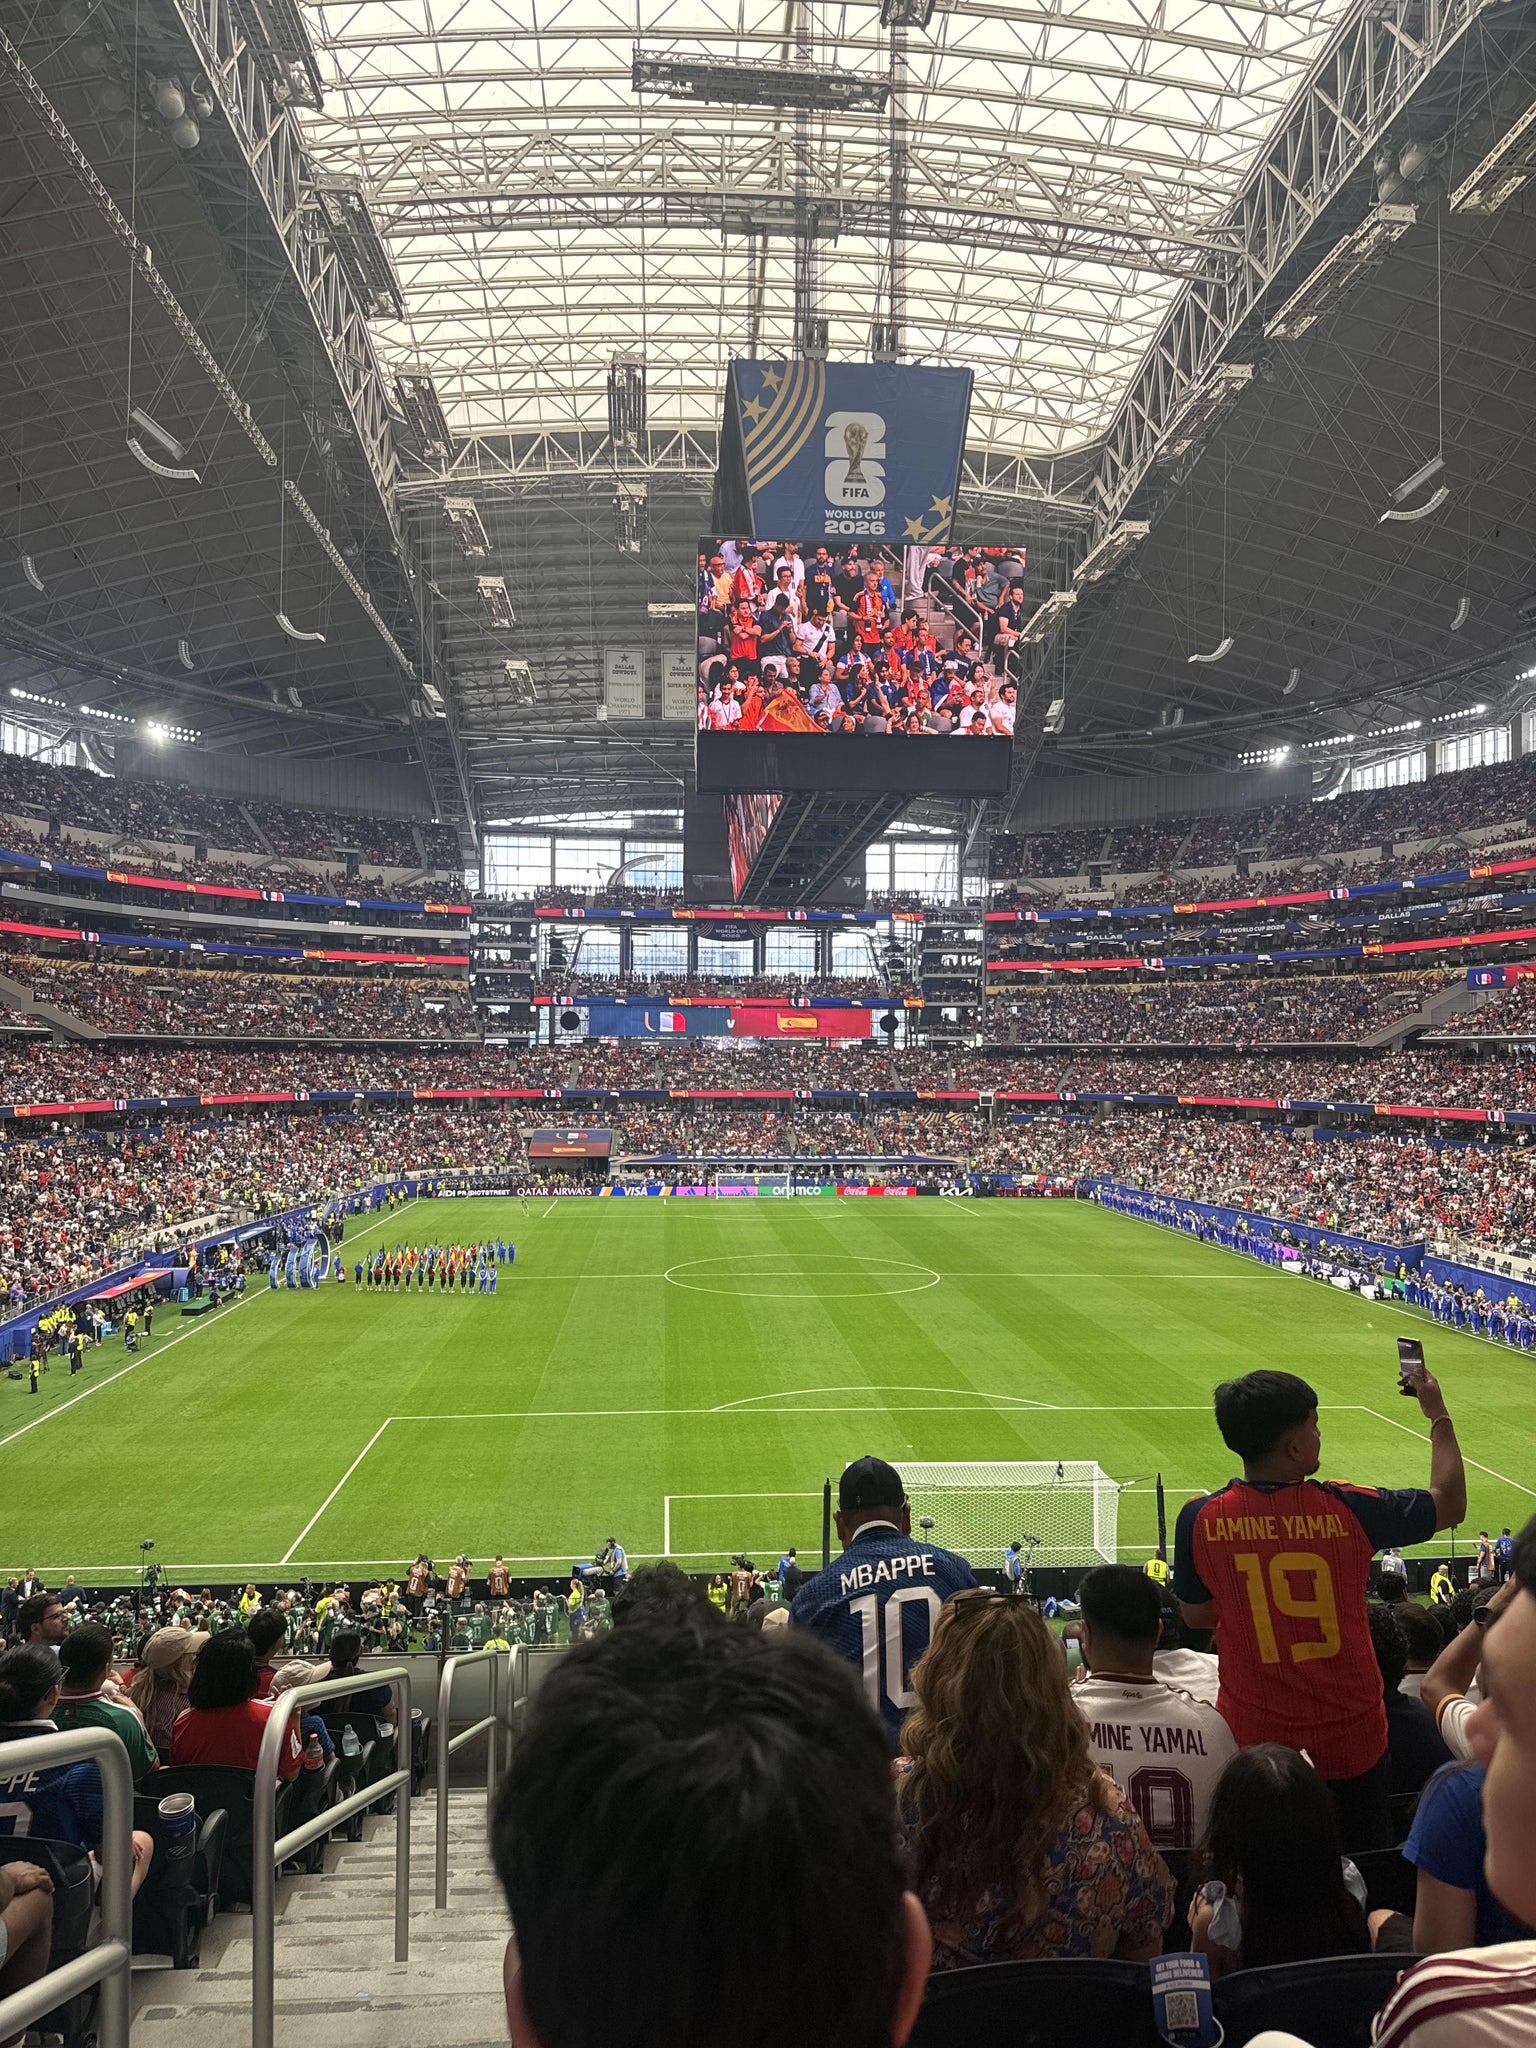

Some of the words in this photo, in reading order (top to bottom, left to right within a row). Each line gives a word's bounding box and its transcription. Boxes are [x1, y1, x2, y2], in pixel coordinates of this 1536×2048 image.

[842, 487, 870, 498] FIFA
[824, 509, 863, 519] WORLD
[864, 510, 886, 520] CUP
[824, 520, 886, 535] 2026
[1378, 911, 1411, 921] DALLAS
[1086, 933, 1123, 941] DALLAS
[457, 1189, 511, 1197] PRDICTSTREET
[516, 1187, 549, 1197] QATAR
[552, 1187, 593, 1196] AIRWAYS
[624, 1186, 648, 1196] VISA
[1203, 1515, 1279, 1542] LAMINE
[1281, 1514, 1349, 1540] YAMAL
[840, 1554, 936, 1596] MBAPPE
[1233, 1552, 1341, 1664] 19
[849, 1586, 943, 1713] 10
[1090, 1722, 1133, 1751] MINE
[1139, 1726, 1208, 1756] YAMAL
